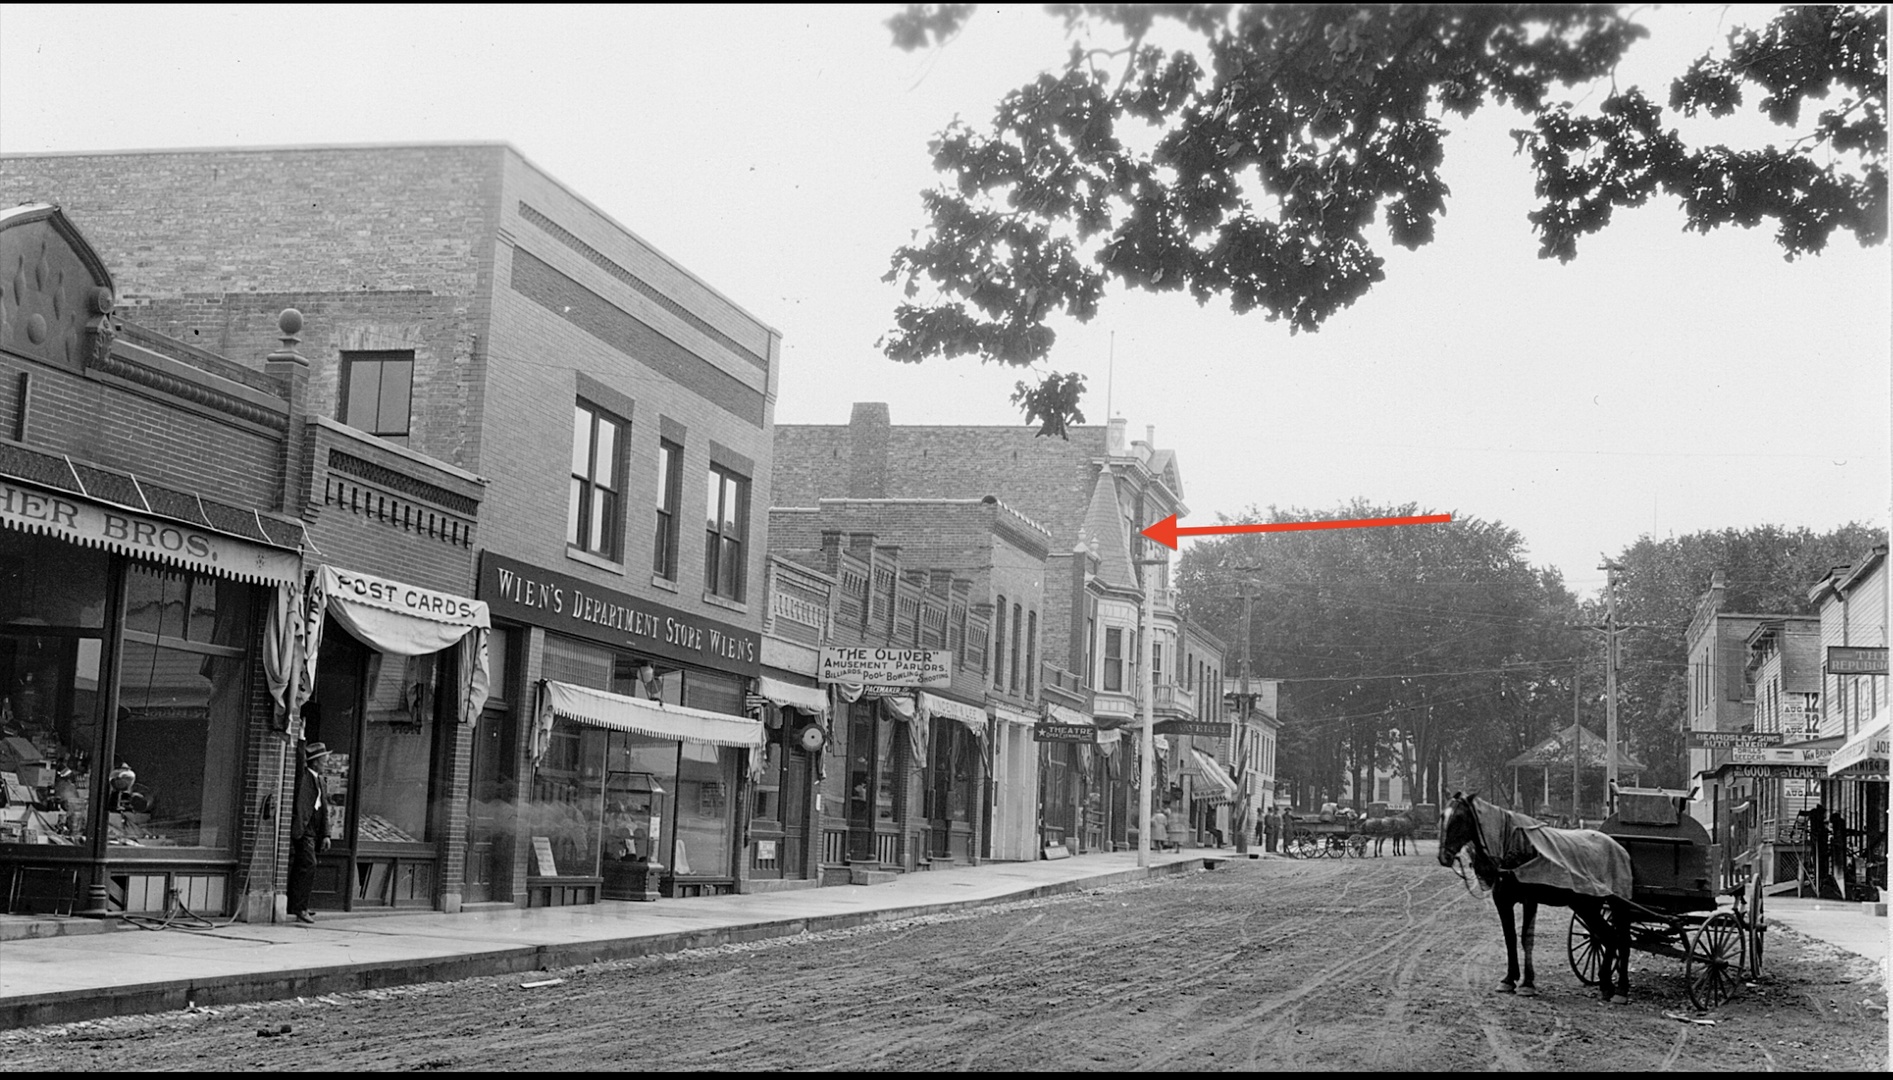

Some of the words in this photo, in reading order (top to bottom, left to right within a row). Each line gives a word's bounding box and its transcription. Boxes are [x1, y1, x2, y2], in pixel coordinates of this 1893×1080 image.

[103, 513, 218, 559] BROS.
[337, 575, 397, 602] POST
[405, 591, 476, 618] CARDS.
[497, 567, 564, 613] WIEN'S
[572, 590, 659, 639] DEPARTMENT
[665, 617, 703, 651] STORE
[708, 628, 754, 663] WIEN'S
[824, 658, 888, 670] AMUSEMENT
[1804, 692, 1819, 713] 12
[1048, 726, 1094, 735] THEATRE
[1805, 714, 1820, 733] 12
[1696, 733, 1751, 742] BEARDSLEY
[1743, 765, 1771, 777] GOOD
[1786, 766, 1814, 778] YEAR
